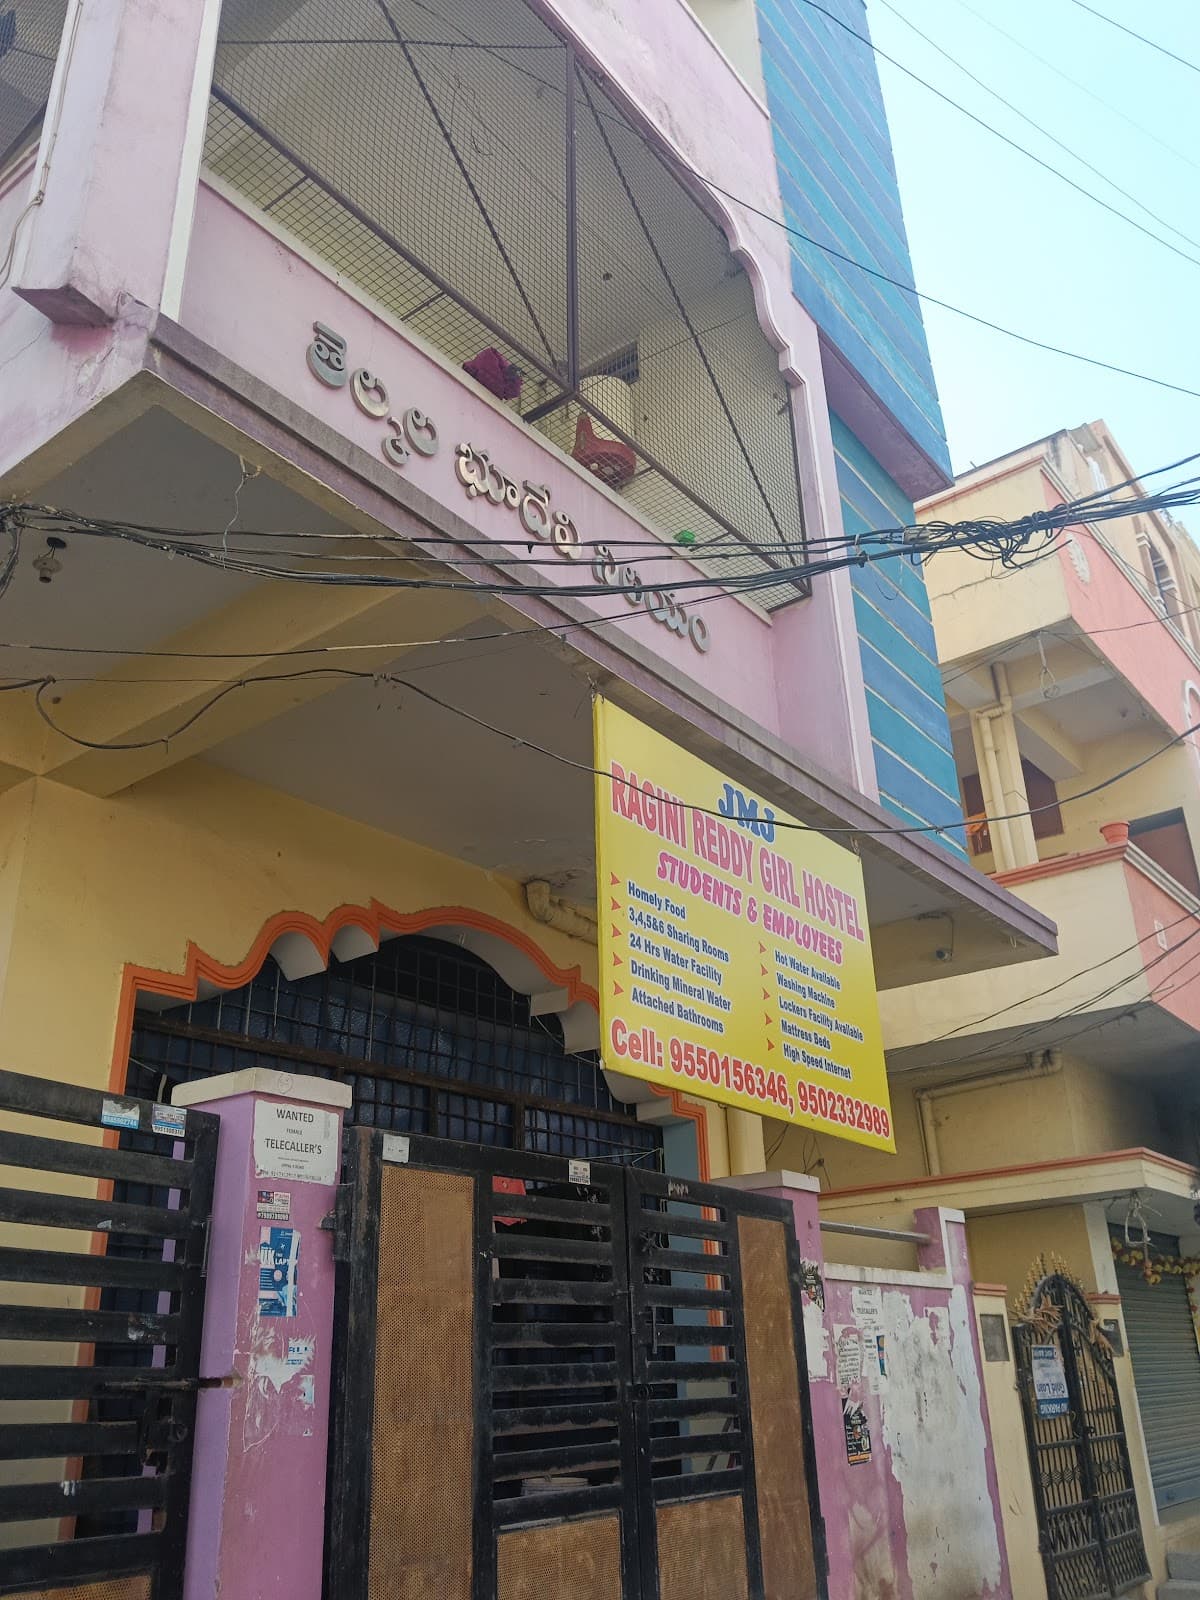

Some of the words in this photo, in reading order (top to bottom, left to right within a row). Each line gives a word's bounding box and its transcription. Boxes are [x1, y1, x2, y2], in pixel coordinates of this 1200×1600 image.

[454, 442, 583, 560] భూదేవి
[718, 783, 776, 843] JMJ
[611, 761, 688, 849] RAGINI
[692, 808, 754, 884] REDDY
[759, 847, 801, 910] GIRL
[802, 870, 865, 942] HOSTEL
[628, 881, 662, 911] Homely
[664, 897, 686, 919] Food
[657, 851, 742, 916] STUDENTS
[746, 896, 758, 923] &
[763, 903, 844, 965] EMPLOYEES
[629, 907, 665, 935] 3,4,5&6
[667, 925, 700, 953] Sharing
[702, 939, 729, 962] Rooms
[630, 933, 642, 950] 24
[644, 938, 660, 957] Hrs
[663, 945, 689, 969] Water
[691, 955, 722, 985] Facility
[775, 949, 788, 966] Hot
[788, 956, 809, 976] Water
[810, 966, 840, 990] Available
[631, 960, 670, 990] Drinking
[672, 975, 705, 1001] Mineral
[707, 989, 731, 1012] Water
[777, 971, 806, 1000] Washing
[807, 987, 835, 1008] Machine
[632, 987, 675, 1016] Attached
[677, 1005, 724, 1033] Bathrooms
[779, 995, 807, 1019] Lockers
[808, 1006, 833, 1032] Facility
[834, 1019, 864, 1041] Available
[781, 1019, 812, 1043] Mattress
[813, 1032, 831, 1050] Beds
[611, 1018, 663, 1067] Cell:
[669, 1038, 794, 1115] 9550156346,
[797, 1080, 890, 1138] 9502332989
[783, 1043, 801, 1065] High
[801, 1051, 823, 1073] Speed
[824, 1059, 851, 1080] Internet
[276, 1108, 314, 1124] WANTED
[265, 1138, 322, 1155] TELECALLER'S
